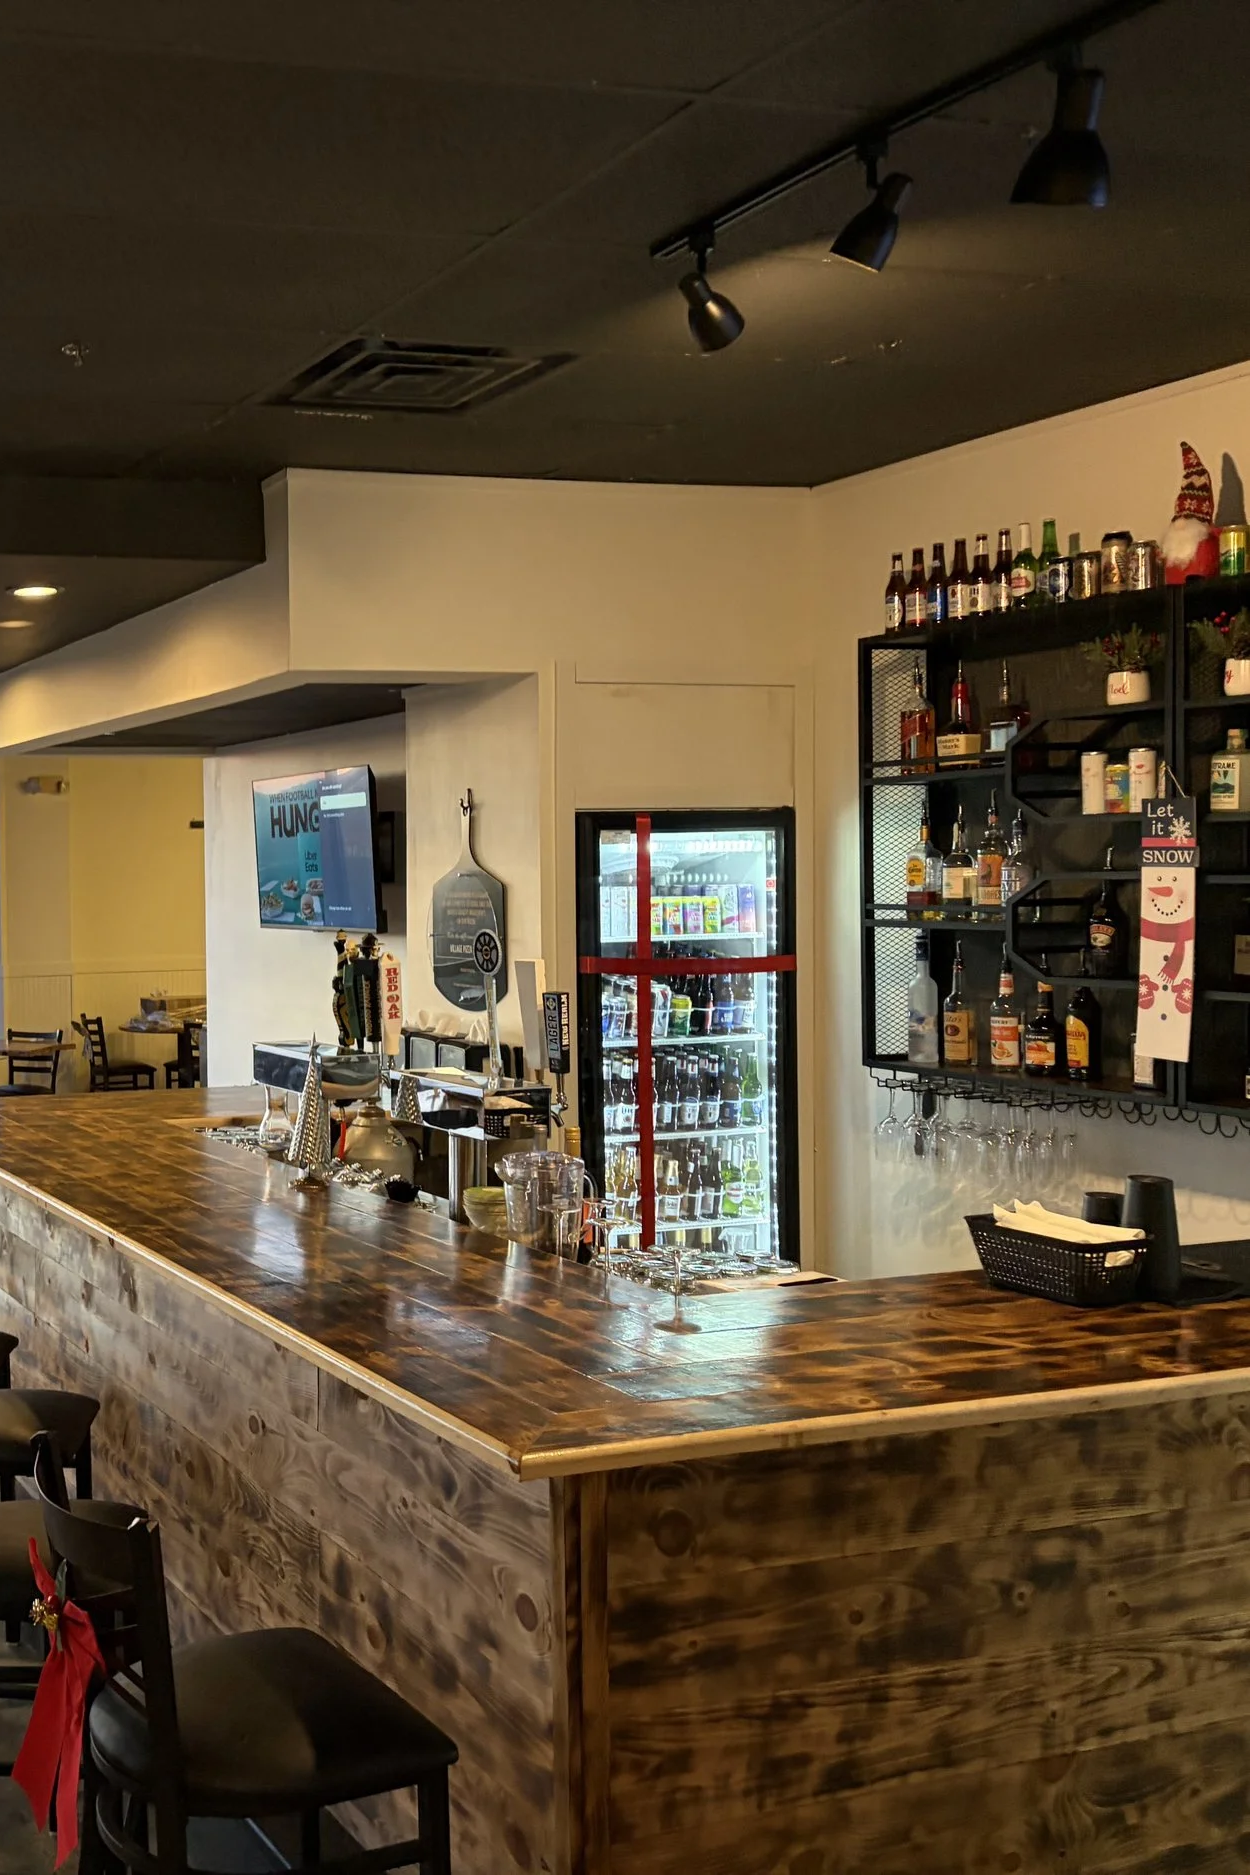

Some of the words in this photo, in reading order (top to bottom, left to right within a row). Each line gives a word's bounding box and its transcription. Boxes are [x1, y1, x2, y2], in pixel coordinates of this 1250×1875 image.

[269, 793, 286, 803] WHEN
[285, 789, 314, 801] FOOTBALL
[1147, 802, 1175, 818] Let
[269, 801, 320, 839] HUNG
[1152, 820, 1164, 836] it
[1142, 849, 1195, 864] SNOW
[304, 862, 319, 873] Eats
[385, 967, 400, 993] RED
[386, 993, 401, 1020] OAK
[548, 1015, 559, 1051] LAGER
[561, 1026, 569, 1045] NEW
